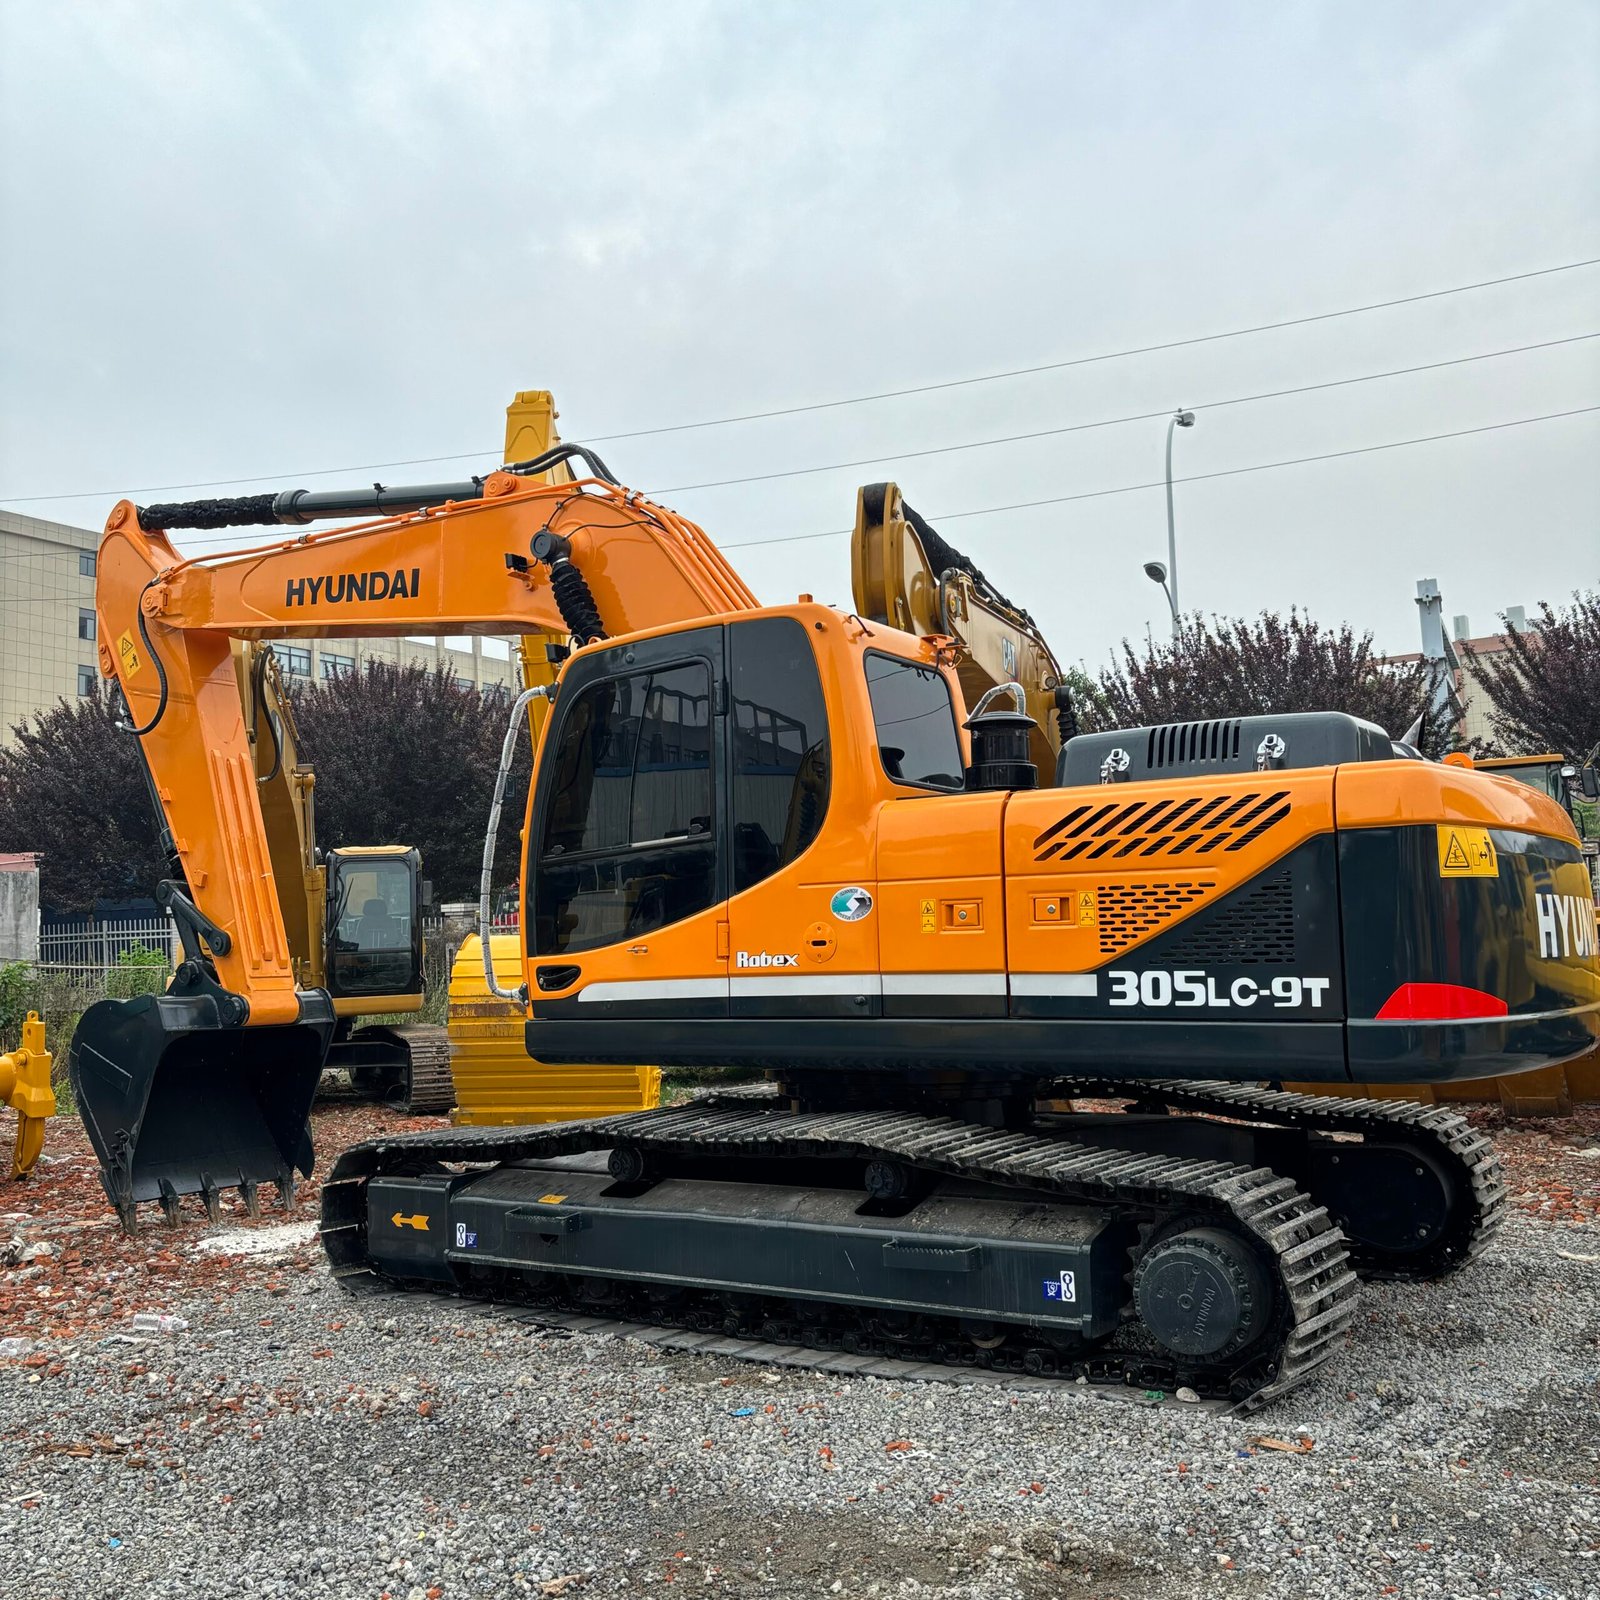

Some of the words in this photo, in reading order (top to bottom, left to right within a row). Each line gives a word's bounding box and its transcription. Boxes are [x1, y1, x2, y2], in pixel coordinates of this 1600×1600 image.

[286, 568, 420, 607] HYUNDAI
[1002, 637, 1016, 678] CAT
[1108, 970, 1330, 1008] 305LC-9T
[1192, 1287, 1216, 1336] HYUNDAI
